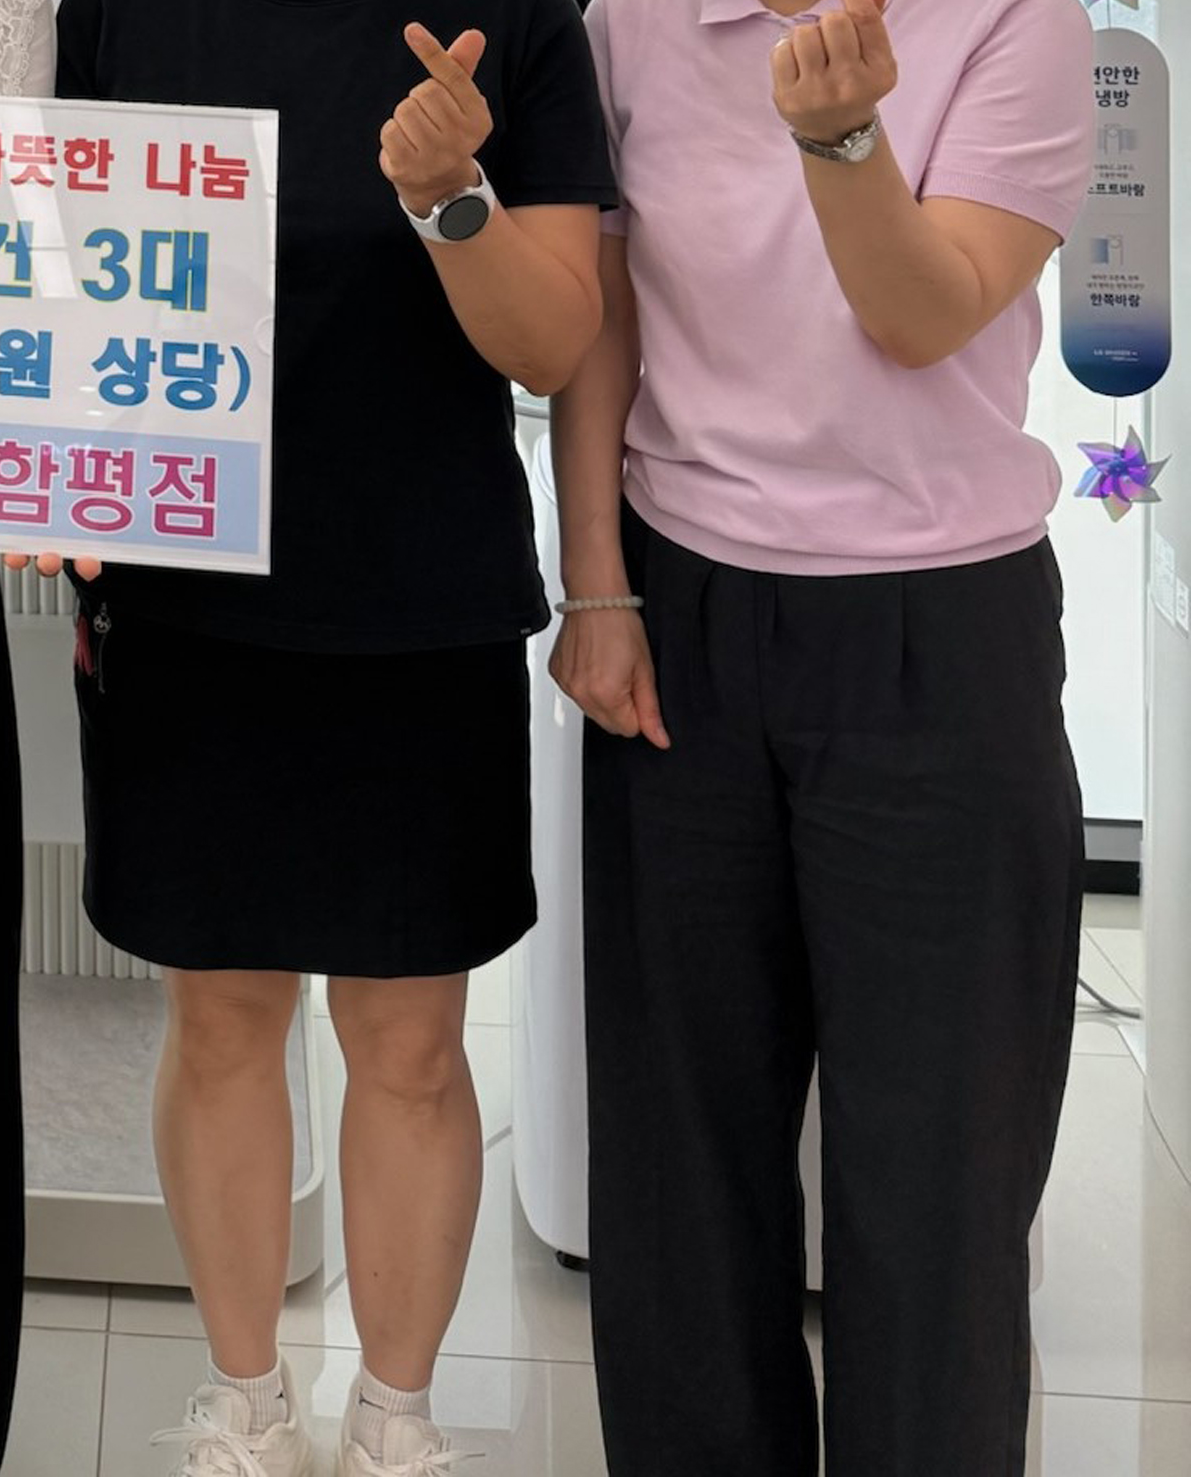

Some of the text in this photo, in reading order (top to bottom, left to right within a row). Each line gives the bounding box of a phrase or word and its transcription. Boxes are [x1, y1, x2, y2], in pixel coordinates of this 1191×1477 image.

[145, 142, 251, 201] 나눔
[81, 228, 211, 313] 3대
[92, 335, 252, 411] 상당)
